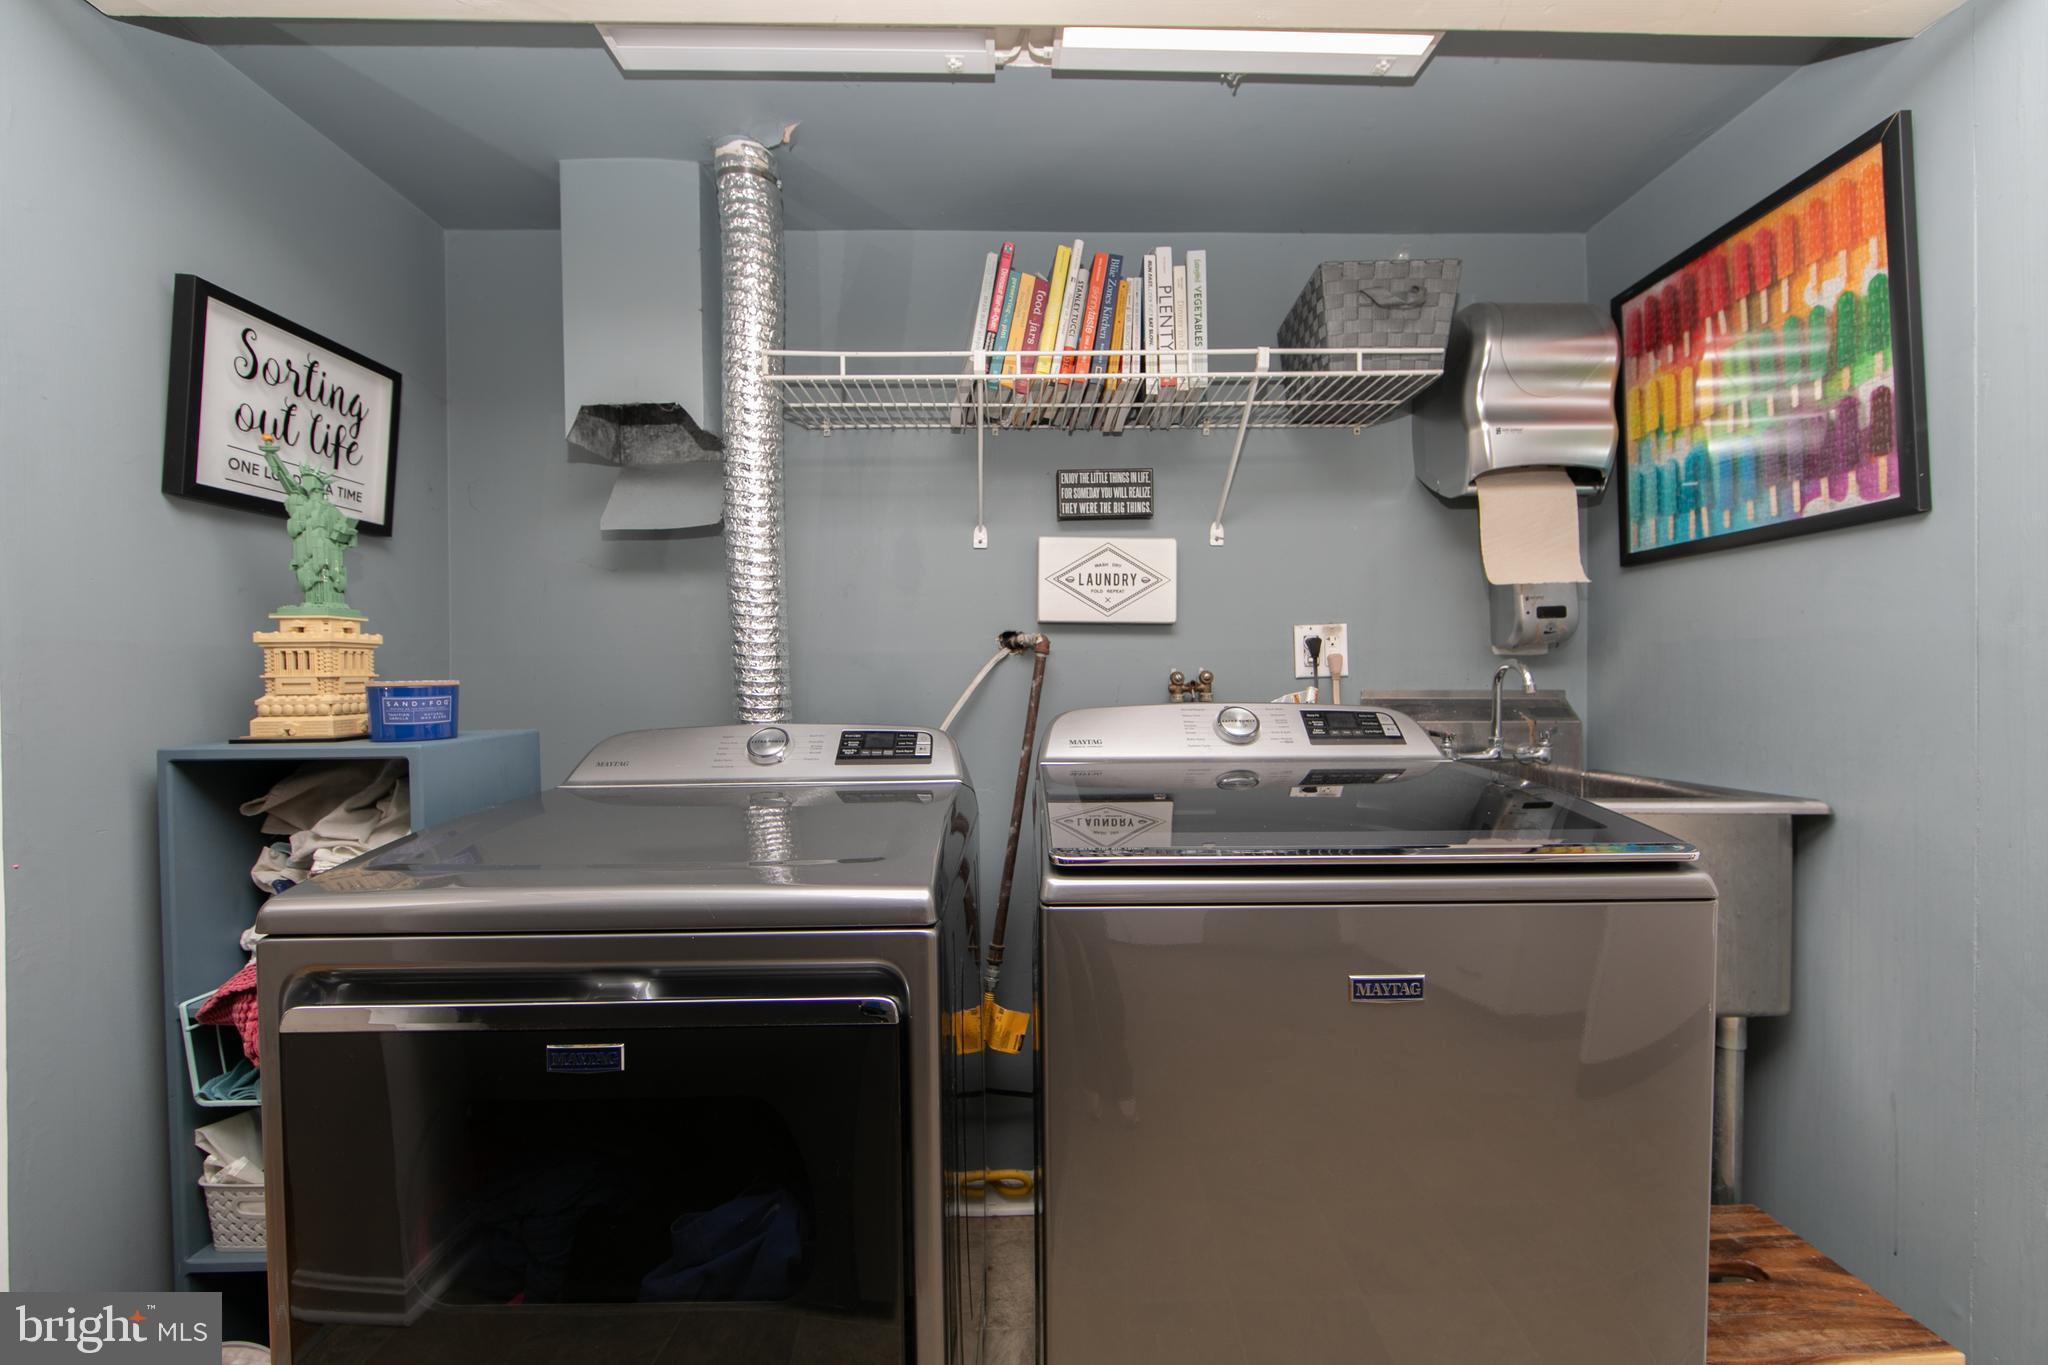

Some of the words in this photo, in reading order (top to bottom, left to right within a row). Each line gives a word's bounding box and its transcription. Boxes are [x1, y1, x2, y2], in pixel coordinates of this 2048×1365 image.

[1111, 258, 1121, 278] Blue
[1033, 289, 1047, 315] food
[1073, 280, 1085, 311] STANLEY
[1104, 279, 1117, 304] Zones
[1068, 312, 1079, 337] TUCCI
[1100, 306, 1112, 339] Kitchen
[1158, 285, 1173, 350] PLENTY
[1193, 286, 1203, 347] VEGETABLES
[1027, 319, 1041, 345] jars
[233, 327, 369, 439] Sorting
[235, 396, 300, 446] out
[310, 410, 364, 470] life
[228, 457, 260, 476] ONE
[337, 486, 363, 503] TIME
[1061, 472, 1079, 484] ENJOY
[1079, 472, 1090, 484] THE
[1090, 472, 1109, 484] LITTLE
[1109, 471, 1130, 483] THINGS
[1130, 471, 1137, 483] IN
[1061, 487, 1073, 499] FOR
[1073, 486, 1100, 499] SOMEDAY
[1100, 486, 1113, 498] YOU
[1113, 486, 1128, 498] WILL
[1128, 486, 1151, 498] REALIZE
[1061, 502, 1078, 514] THEY
[1078, 502, 1098, 514] WERE
[1099, 502, 1112, 513] THE
[1113, 501, 1125, 513] BIG
[1126, 501, 1152, 513] THINGS.
[1078, 572, 1137, 587] LAUNDRY
[1355, 982, 1421, 997] MAYTAG
